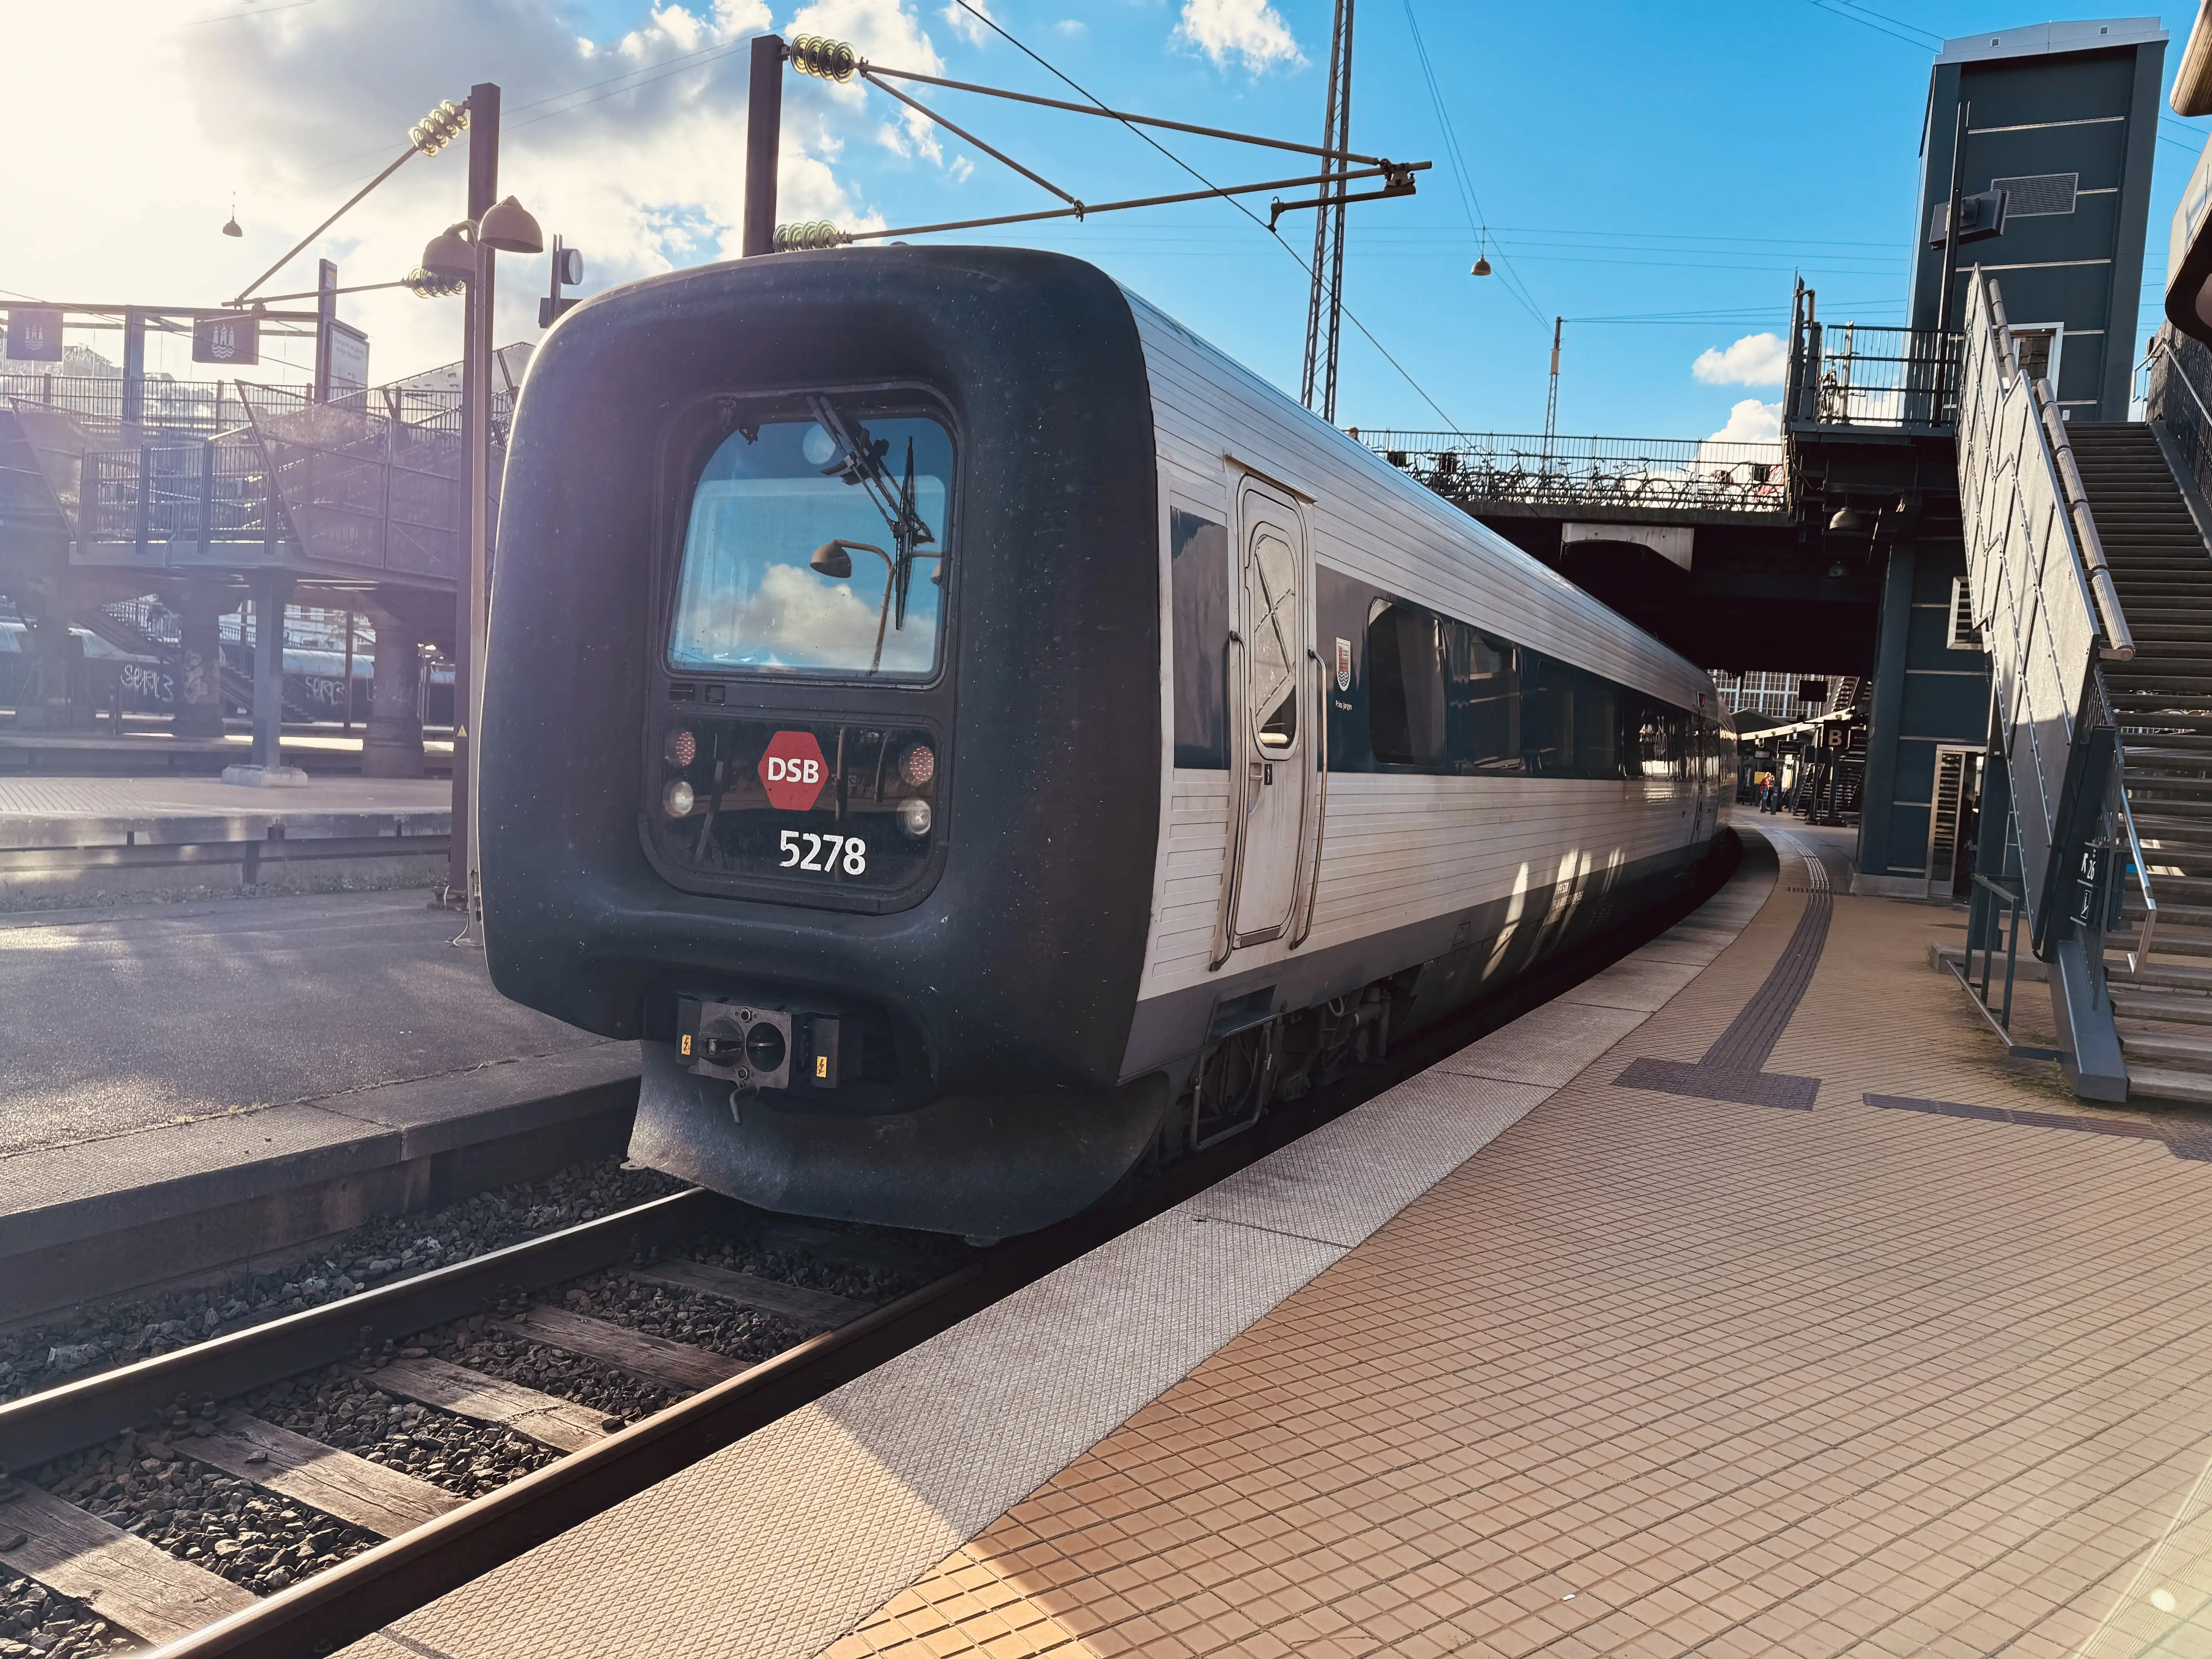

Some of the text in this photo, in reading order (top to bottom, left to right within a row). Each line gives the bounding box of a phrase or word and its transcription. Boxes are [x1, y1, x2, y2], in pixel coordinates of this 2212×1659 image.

[1829, 730, 1842, 746] B
[768, 757, 819, 783] DSB
[779, 830, 866, 875] 5278
[2087, 859, 2096, 880] 26
